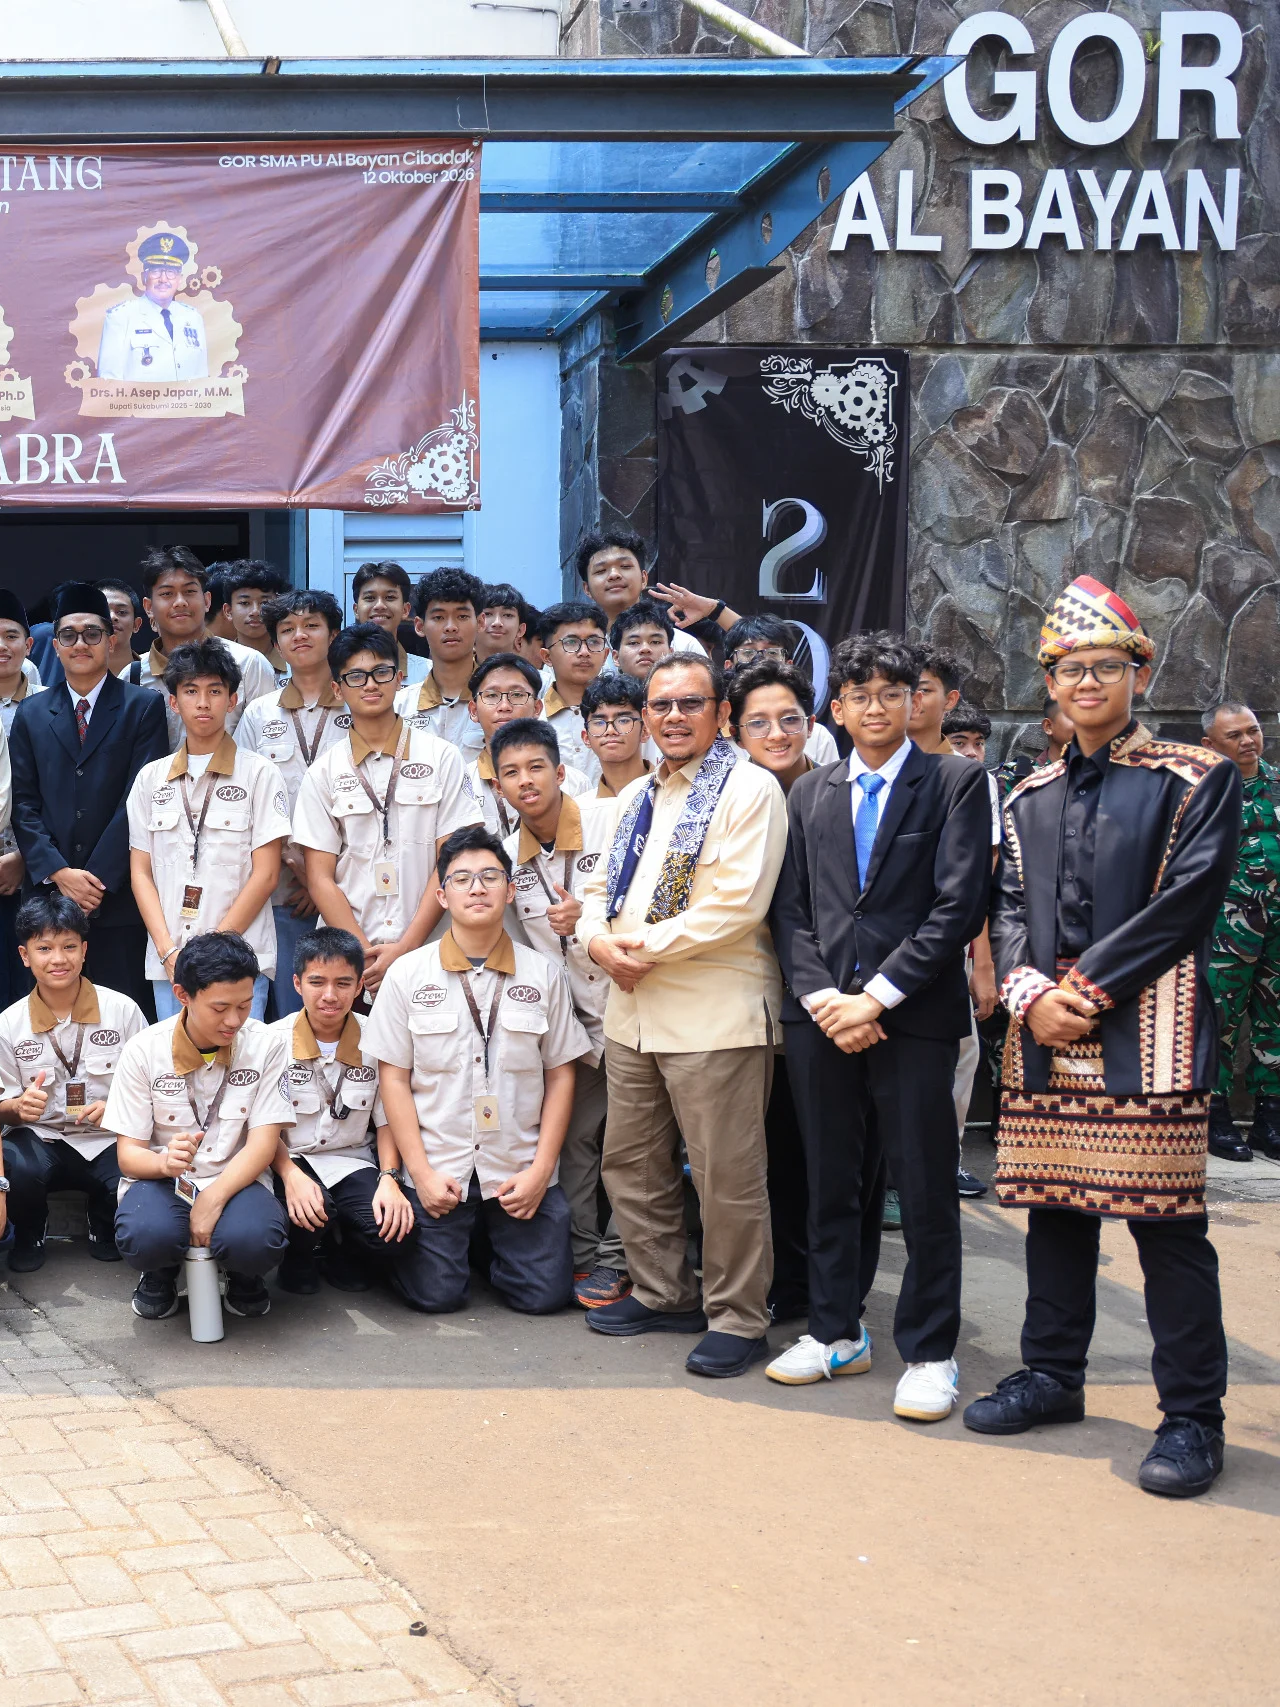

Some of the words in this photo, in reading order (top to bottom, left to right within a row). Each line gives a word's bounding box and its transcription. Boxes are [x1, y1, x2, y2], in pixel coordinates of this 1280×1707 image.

[943, 11, 1243, 145] GOR
[218, 155, 256, 168] GOR
[260, 154, 297, 168] SMA
[301, 154, 322, 167] PU
[326, 153, 341, 167] Al
[346, 152, 399, 170] Bayan
[402, 149, 474, 166] Cibadak
[362, 171, 377, 184] 12
[379, 170, 438, 184] Oktober
[441, 168, 475, 182] 2026
[829, 170, 942, 251] AL
[969, 168, 1240, 251] BAYAN
[90, 388, 113, 398] Drs.
[116, 389, 128, 398] H.
[130, 388, 160, 400] Asep
[163, 388, 202, 401] Japar,
[204, 387, 233, 397] M.M.
[109, 402, 133, 412] Bupati
[133, 402, 170, 410] Sukabumi
[335, 715, 352, 728] 20
